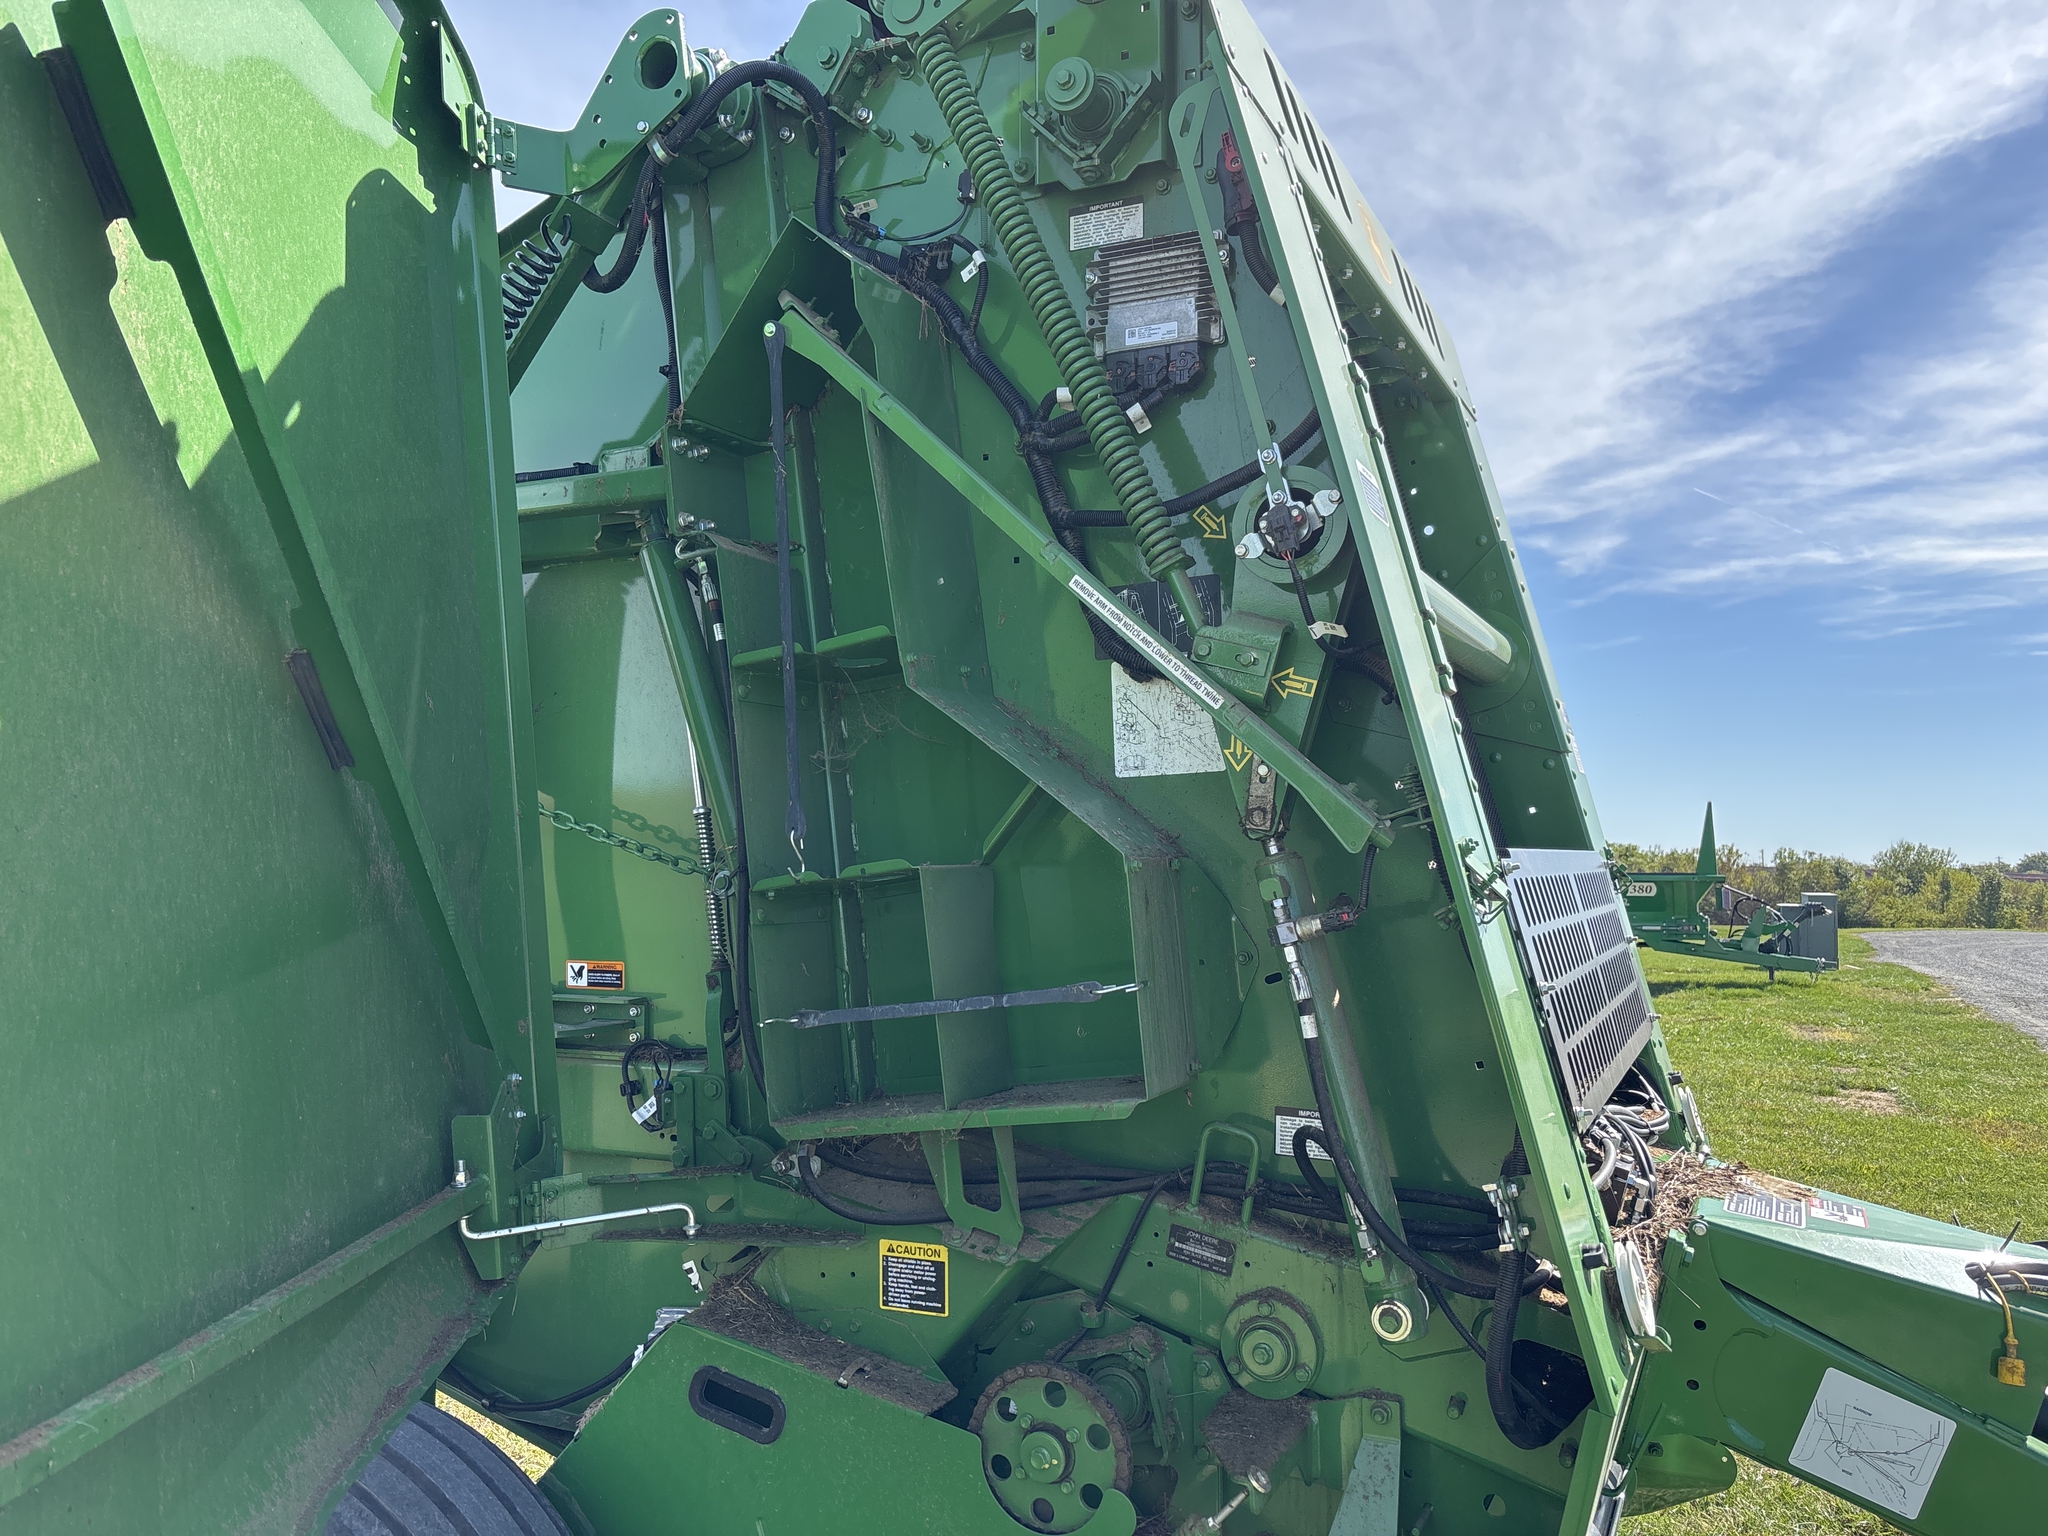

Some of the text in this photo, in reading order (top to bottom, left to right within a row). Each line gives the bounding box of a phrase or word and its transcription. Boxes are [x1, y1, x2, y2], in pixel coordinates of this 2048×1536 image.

[1089, 200, 1123, 211] IMPORTANT
[1073, 579, 1221, 706] REMOVE ARM FROM NOTCH AND LOWER TO THREAD TWINE
[1630, 884, 1652, 894] 380
[1186, 1231, 1201, 1239] JOHN
[1202, 1235, 1219, 1244] DEERE
[896, 1244, 940, 1258] CAUTION
[1852, 1405, 1873, 1417] NARROW
